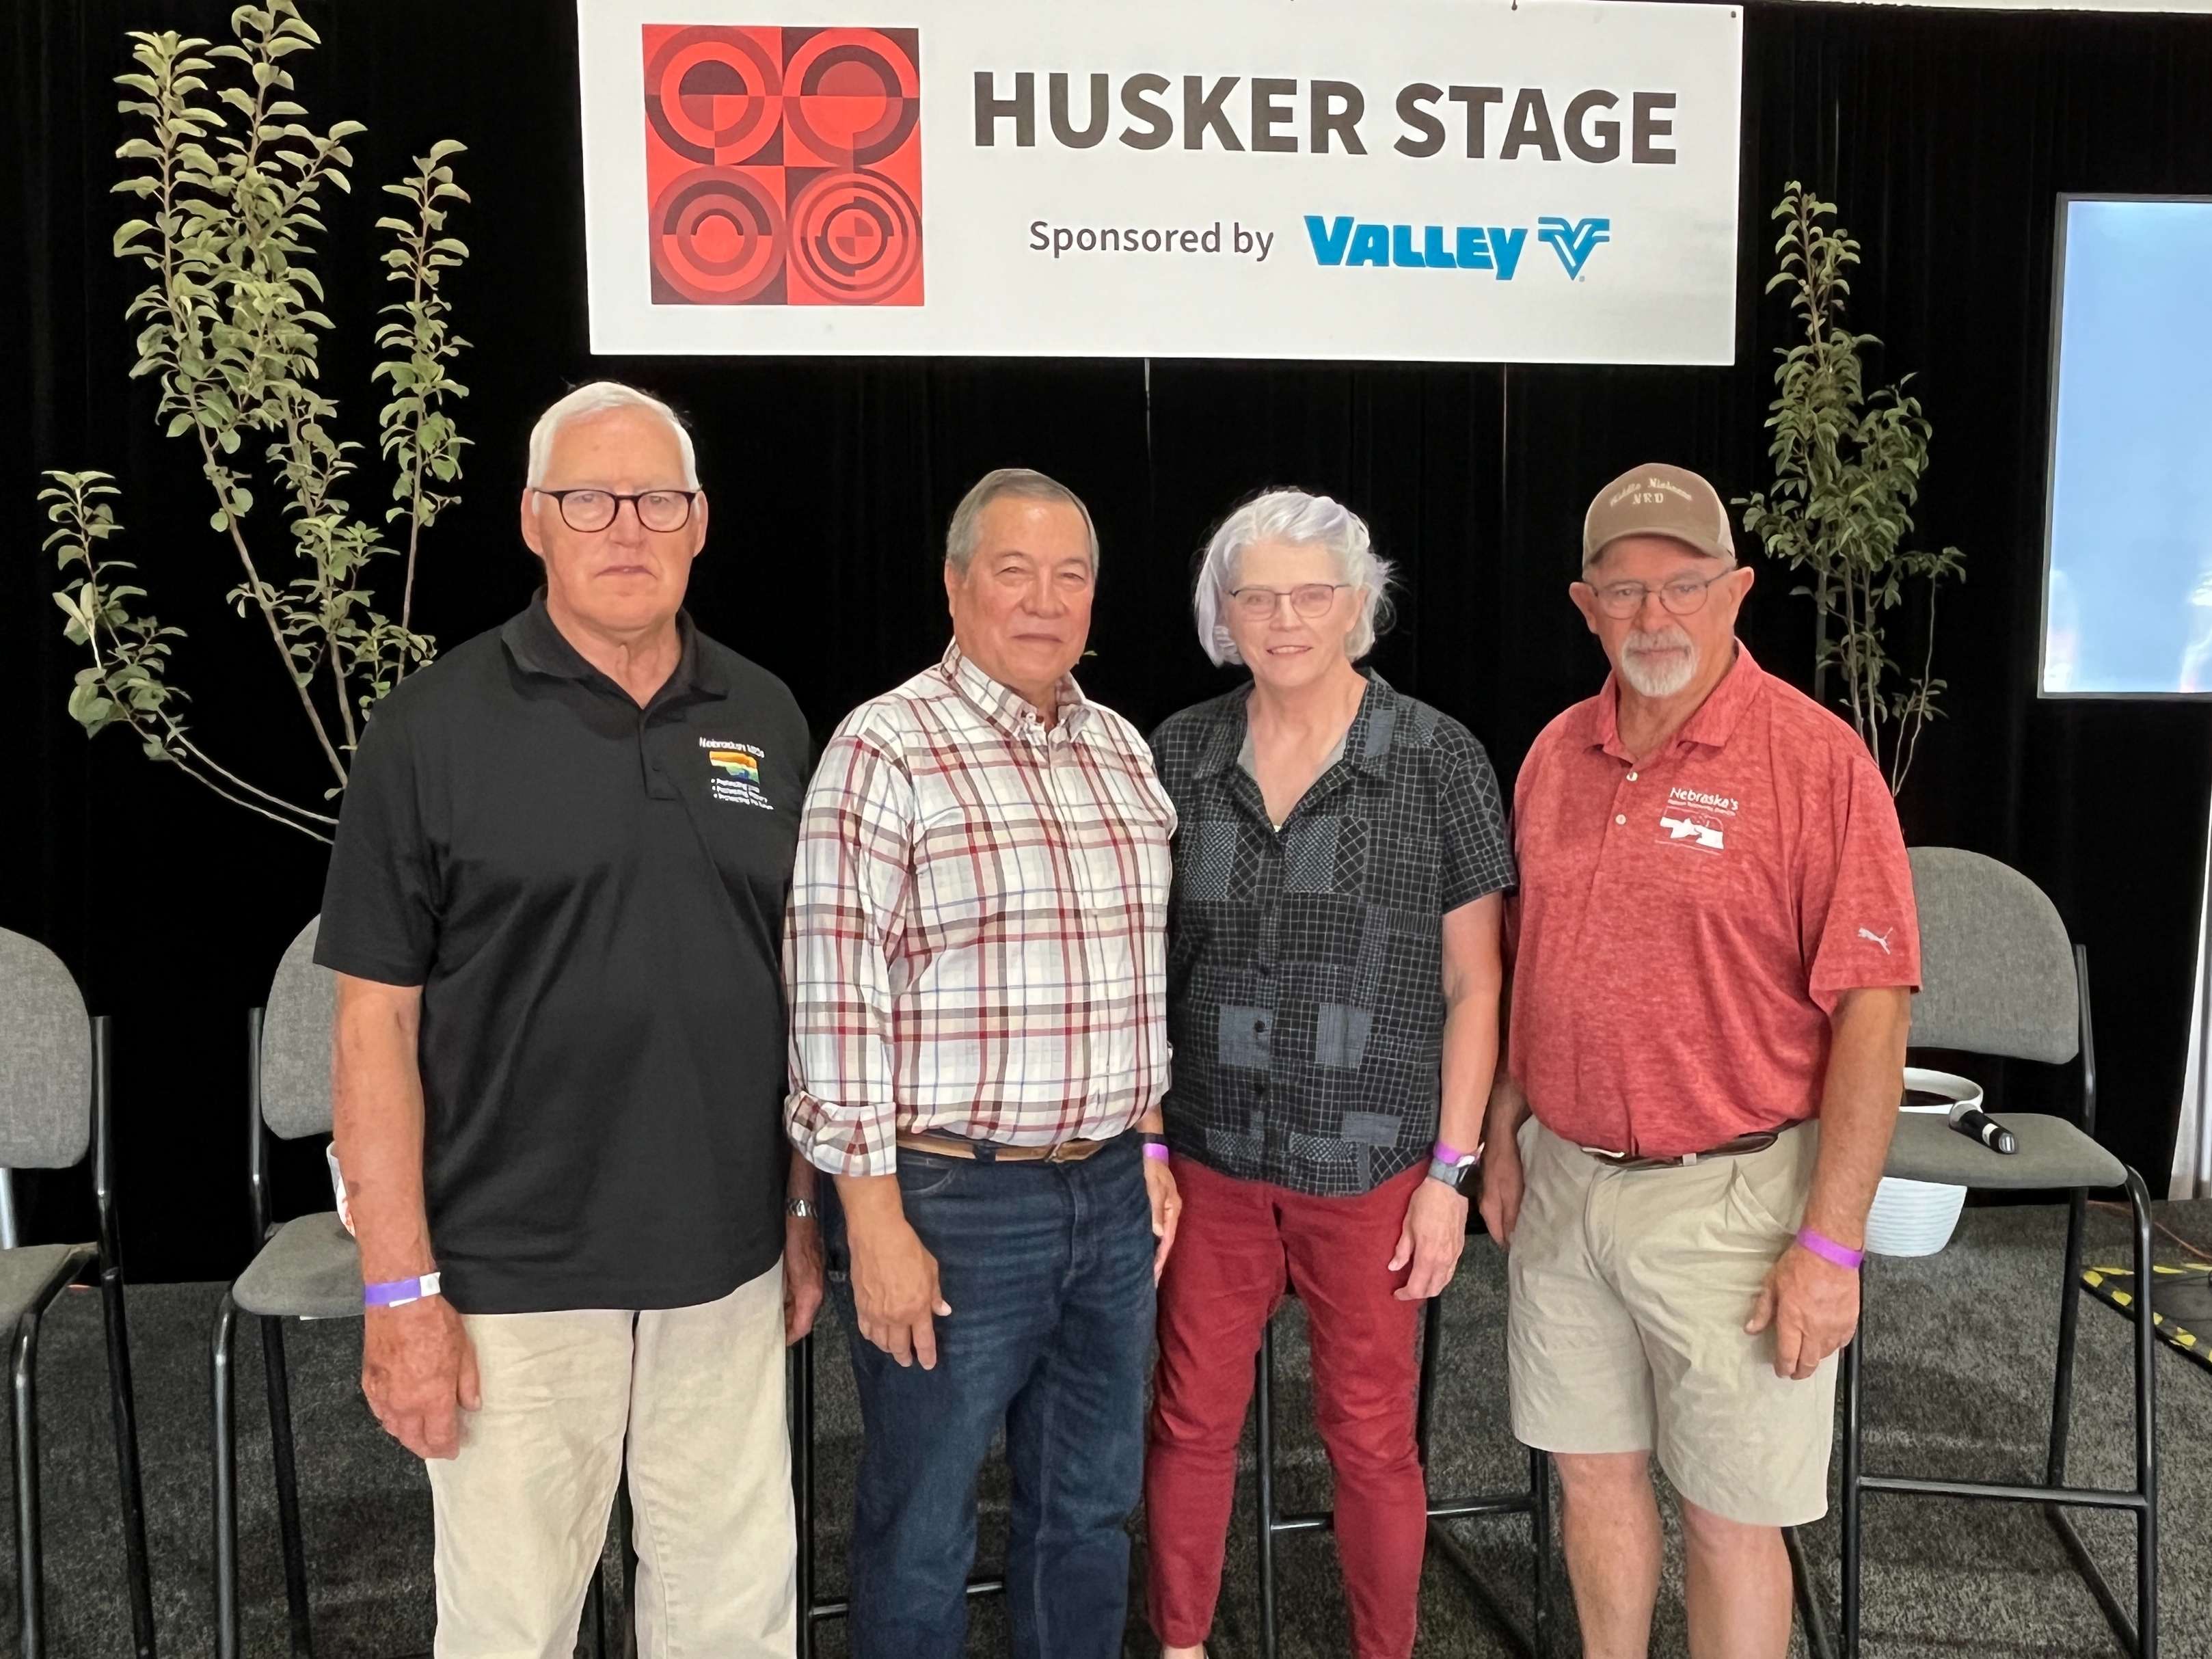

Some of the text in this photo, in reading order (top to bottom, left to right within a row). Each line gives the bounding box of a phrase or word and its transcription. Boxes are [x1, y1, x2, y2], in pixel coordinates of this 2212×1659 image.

[975, 72, 1675, 164] HUSKER STAGE
[1030, 221, 1273, 261] Sponsored by
[1304, 215, 1528, 280] VALLEY
[1669, 787, 1738, 810] Nebraska's
